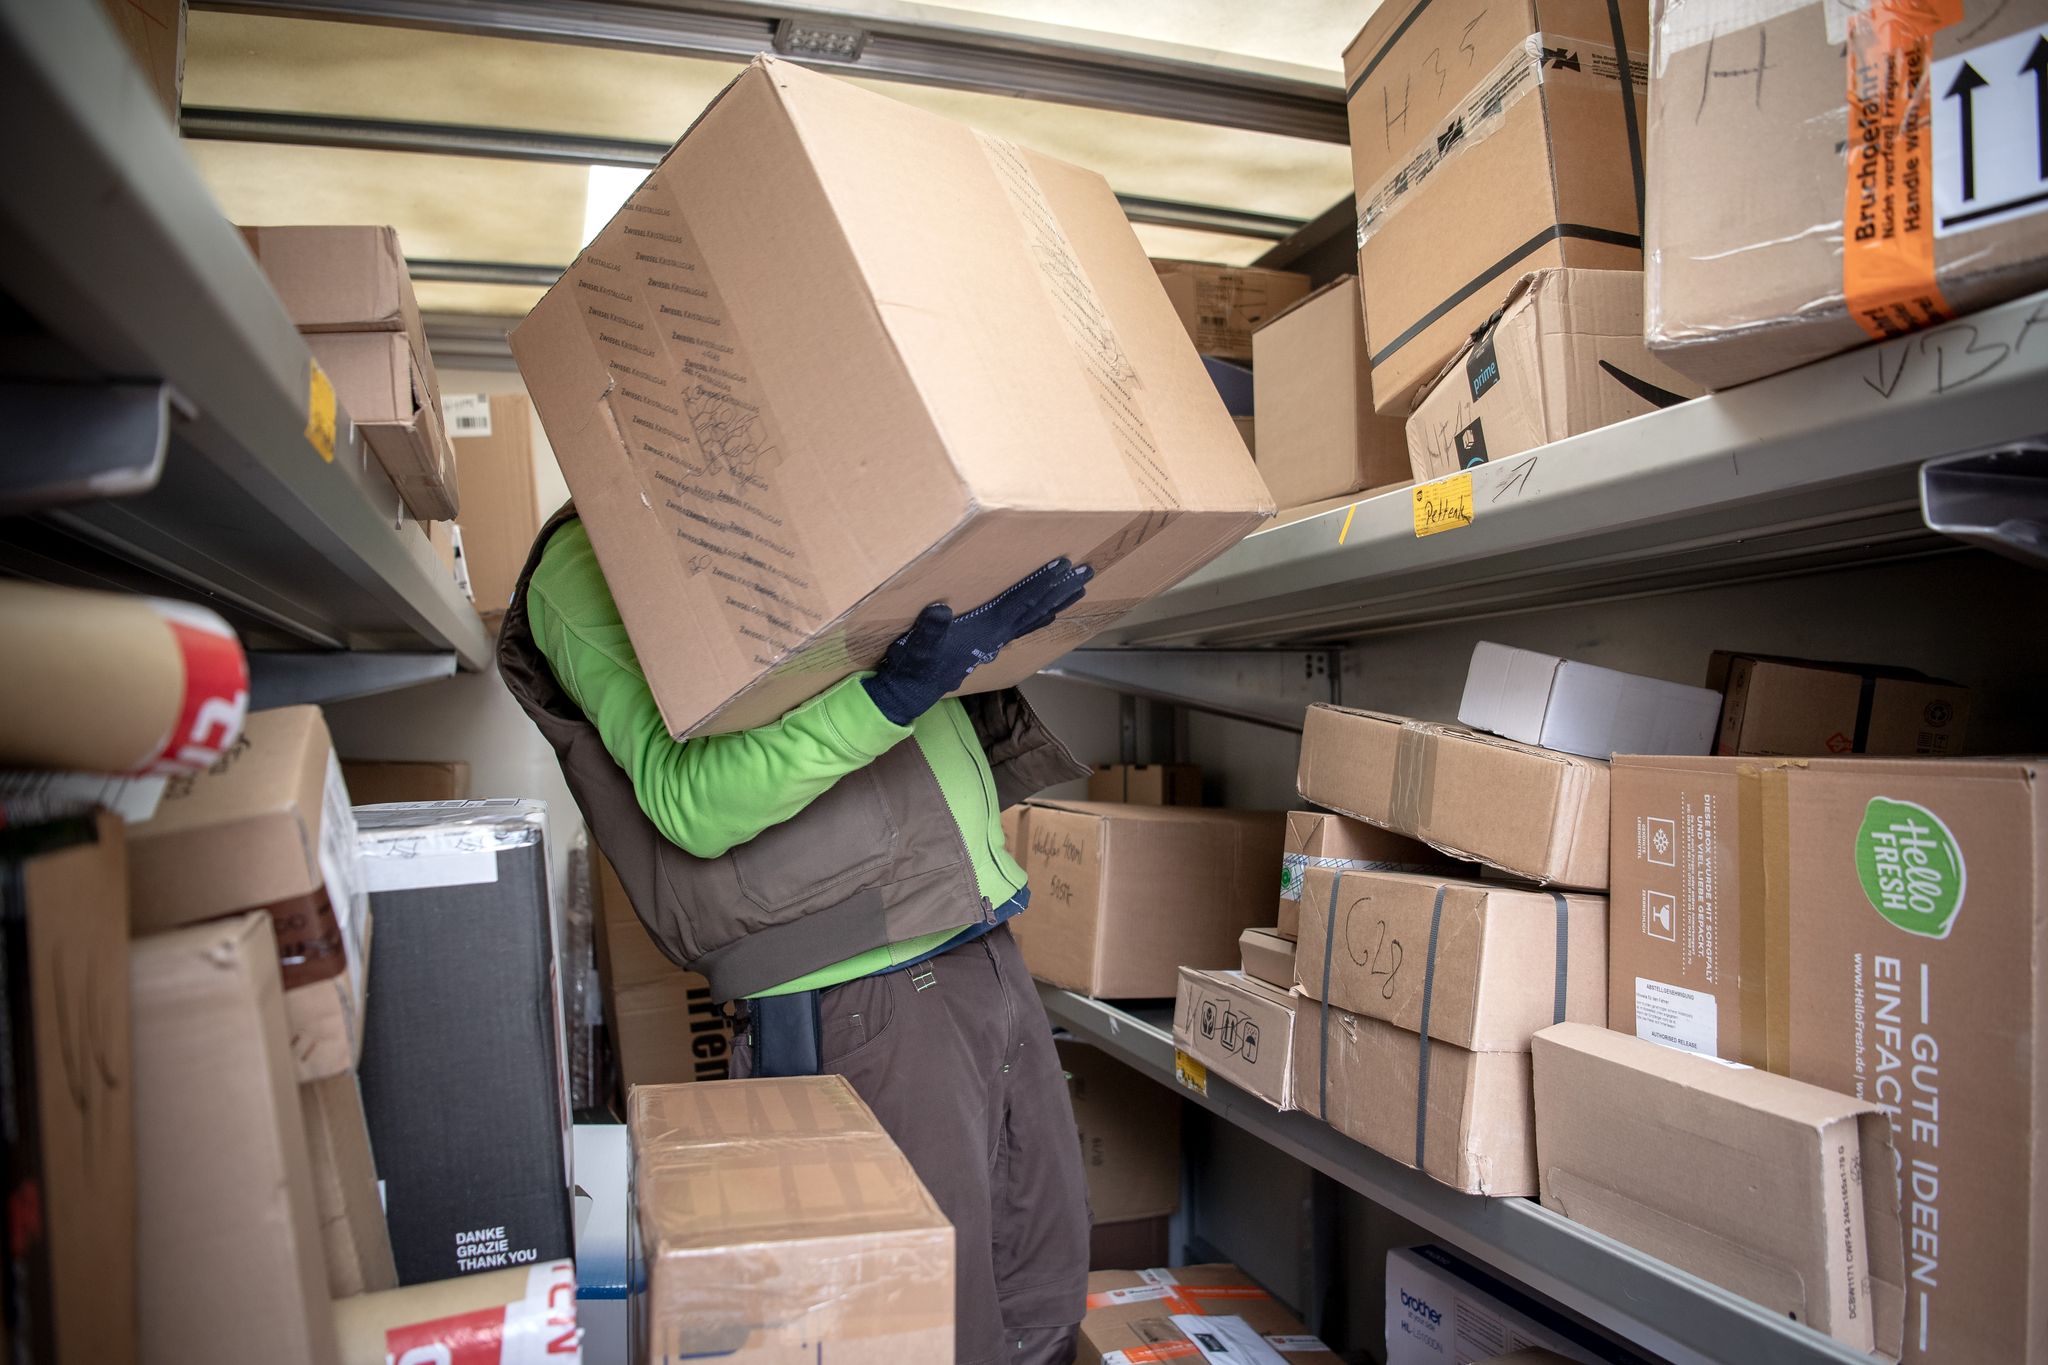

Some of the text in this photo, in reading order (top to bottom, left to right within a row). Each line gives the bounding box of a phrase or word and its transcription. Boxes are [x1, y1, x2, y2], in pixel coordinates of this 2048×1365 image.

[1902, 158, 1921, 232] Handle
[1882, 194, 1896, 239] Nicht
[1473, 361, 1496, 395] prime
[1871, 831, 1909, 912] FRESH
[1889, 818, 1943, 914] Hello
[1853, 953, 1864, 1073] www.HelloFresh.de
[1651, 1031, 1697, 1049] AUTHORISED RELEASE
[1910, 1033, 1939, 1288] GUTE IDEEN
[455, 1226, 505, 1245] DANKE
[456, 1239, 509, 1258] GRAZIE
[457, 1248, 537, 1272] THANK YOU
[1400, 1287, 1443, 1325] brother
